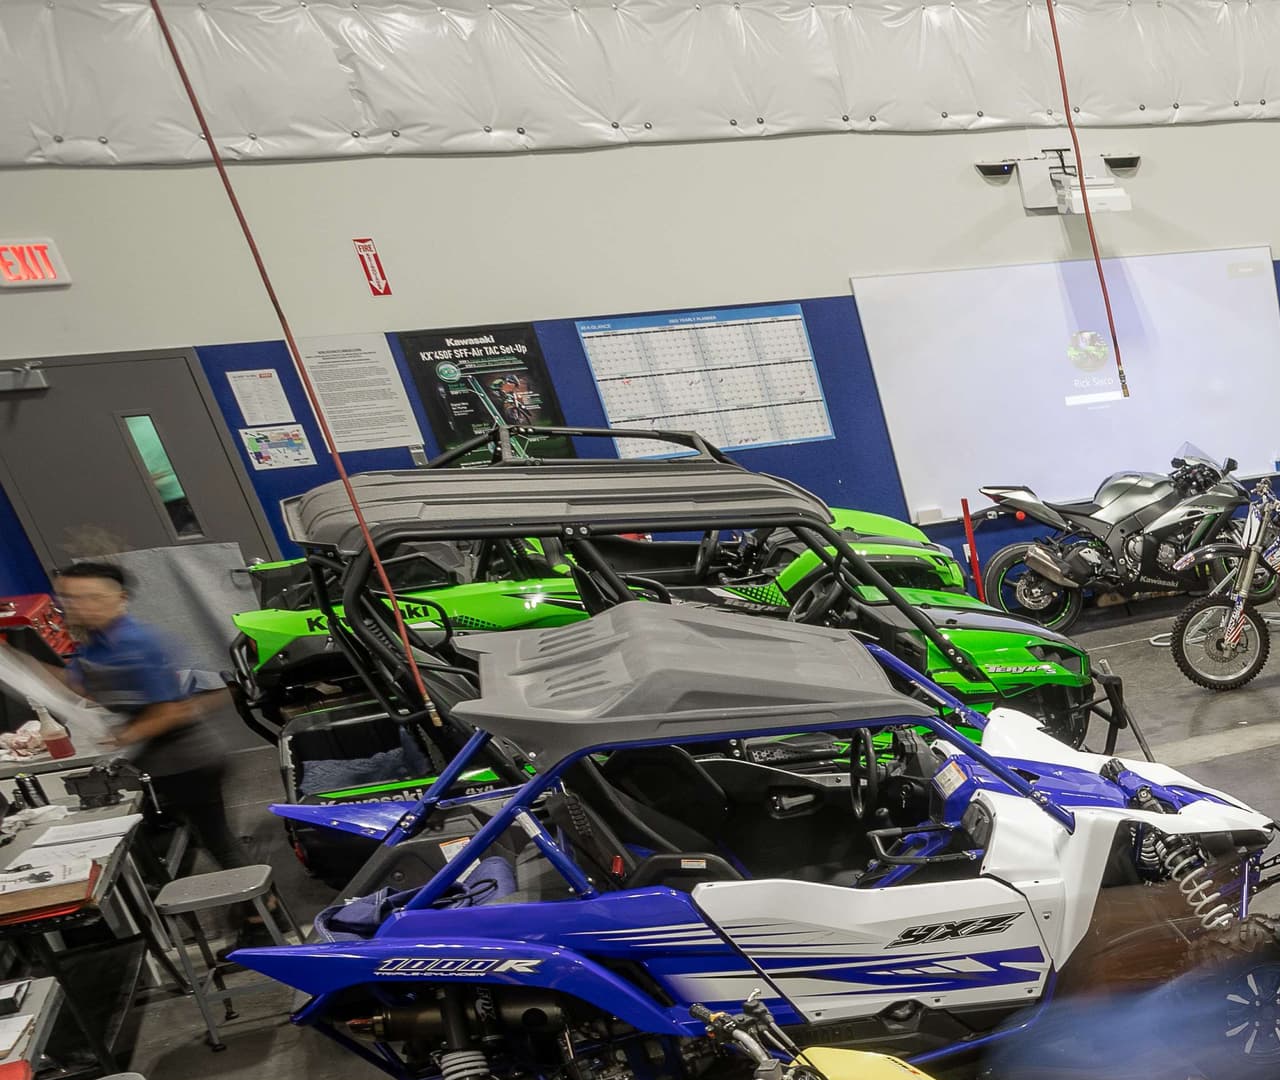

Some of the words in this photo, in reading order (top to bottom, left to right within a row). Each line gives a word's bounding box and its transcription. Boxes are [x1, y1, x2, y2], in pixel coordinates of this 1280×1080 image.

[0, 245, 57, 280] EXIT
[445, 335, 495, 346] Kawasaki
[484, 345, 500, 356] TAC
[500, 343, 528, 355] Set-Up
[884, 911, 1026, 950] YXZ
[378, 958, 543, 973] 1000R
